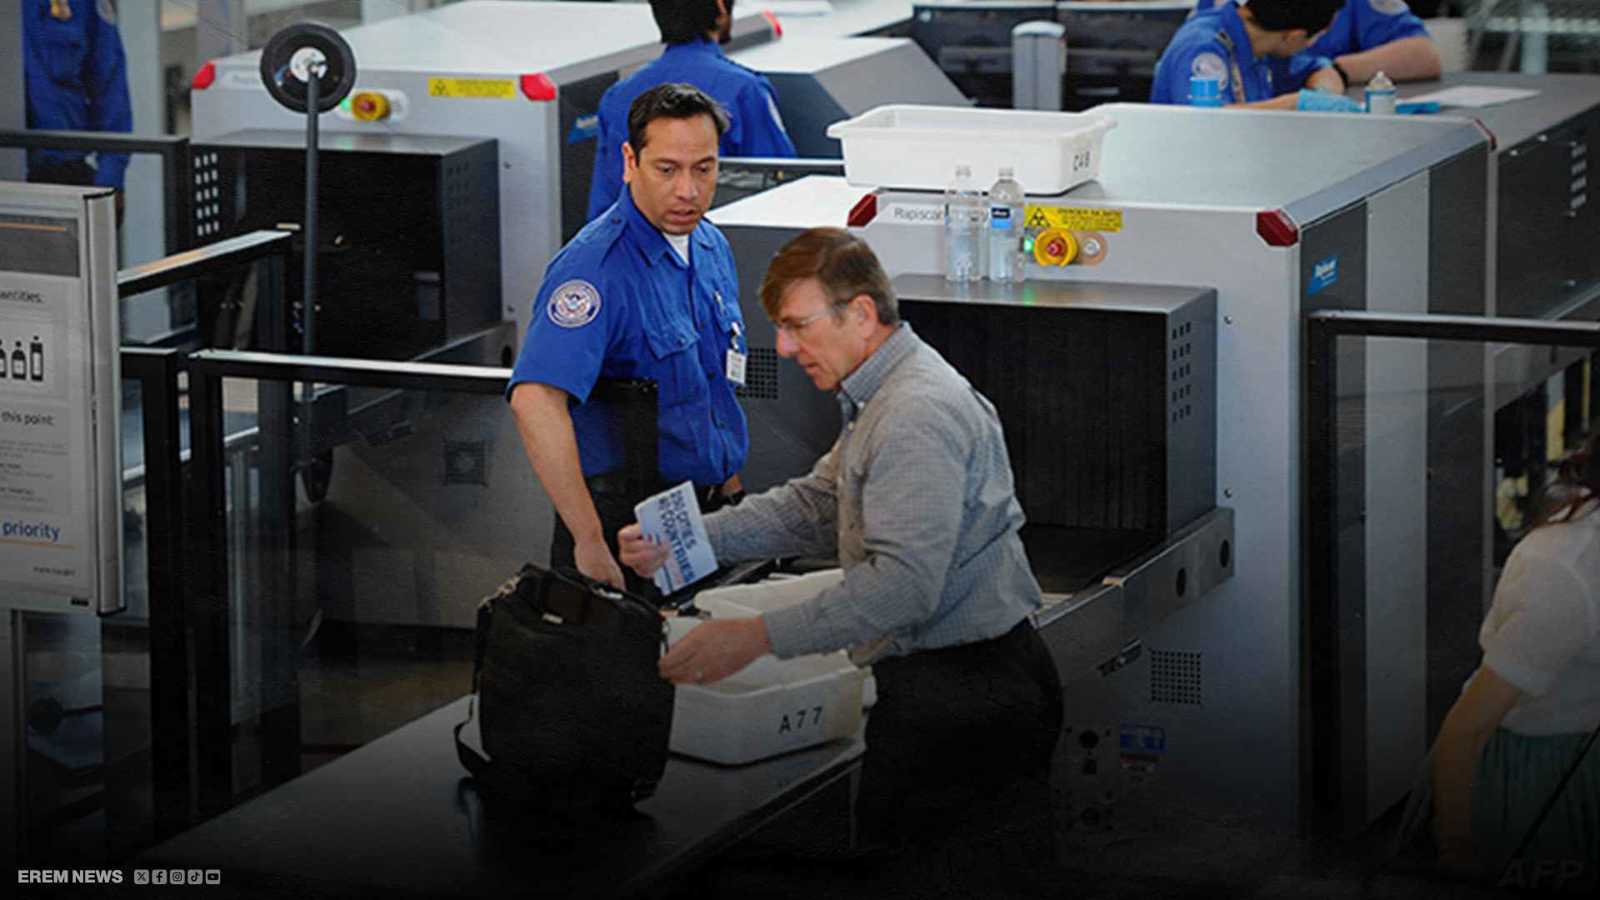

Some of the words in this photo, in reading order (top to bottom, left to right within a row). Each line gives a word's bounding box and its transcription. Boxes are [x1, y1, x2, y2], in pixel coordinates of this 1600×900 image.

[2, 411, 22, 424] this
[3, 520, 60, 542] priority
[676, 511, 697, 550] CITIES
[661, 511, 696, 583] COUNTRIES
[778, 706, 823, 735] A77
